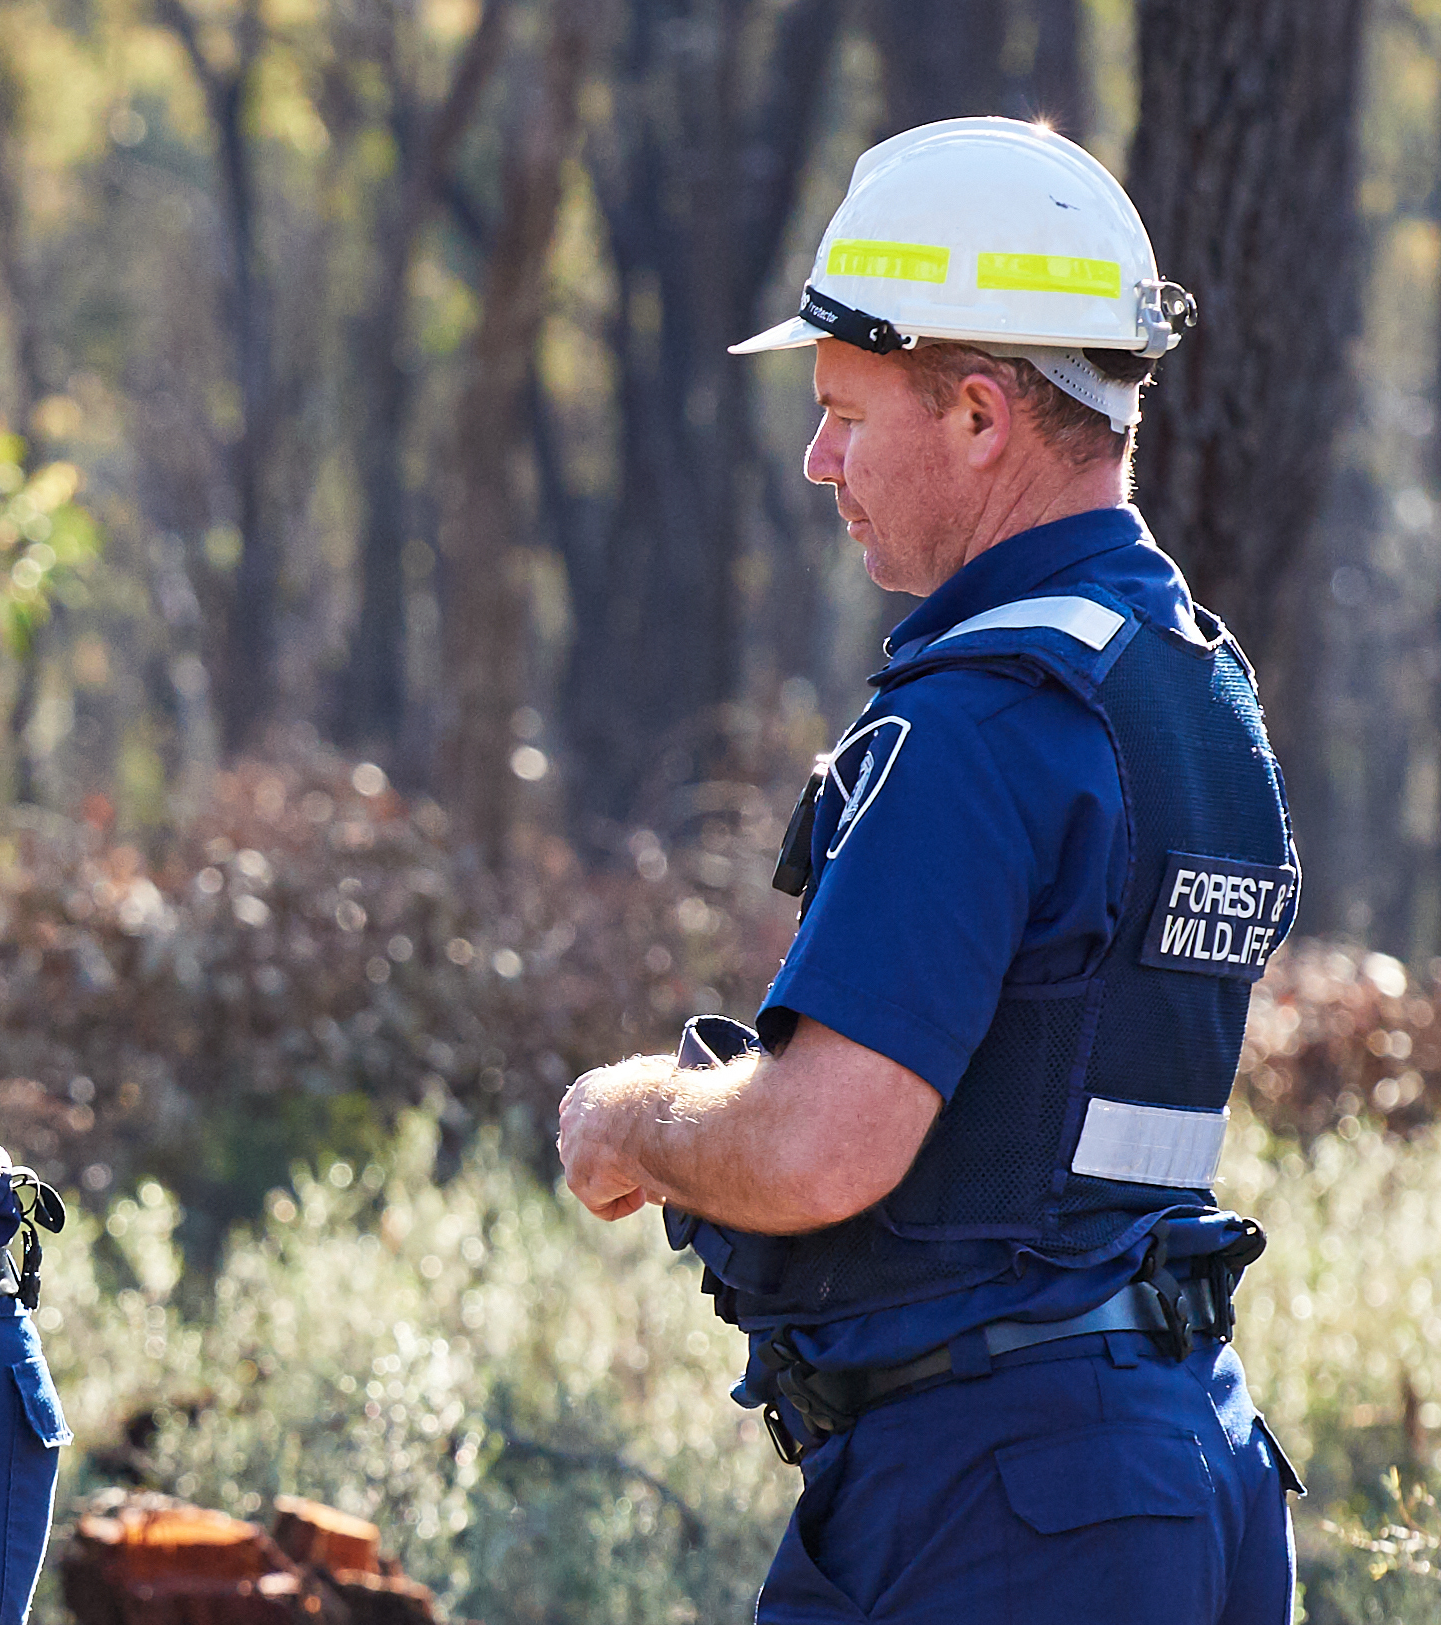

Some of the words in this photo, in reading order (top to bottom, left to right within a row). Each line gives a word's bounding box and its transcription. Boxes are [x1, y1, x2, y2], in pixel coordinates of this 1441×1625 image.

[1168, 869, 1275, 920] FOREST
[1271, 884, 1287, 922] &
[1160, 914, 1275, 966] WILDIFE
